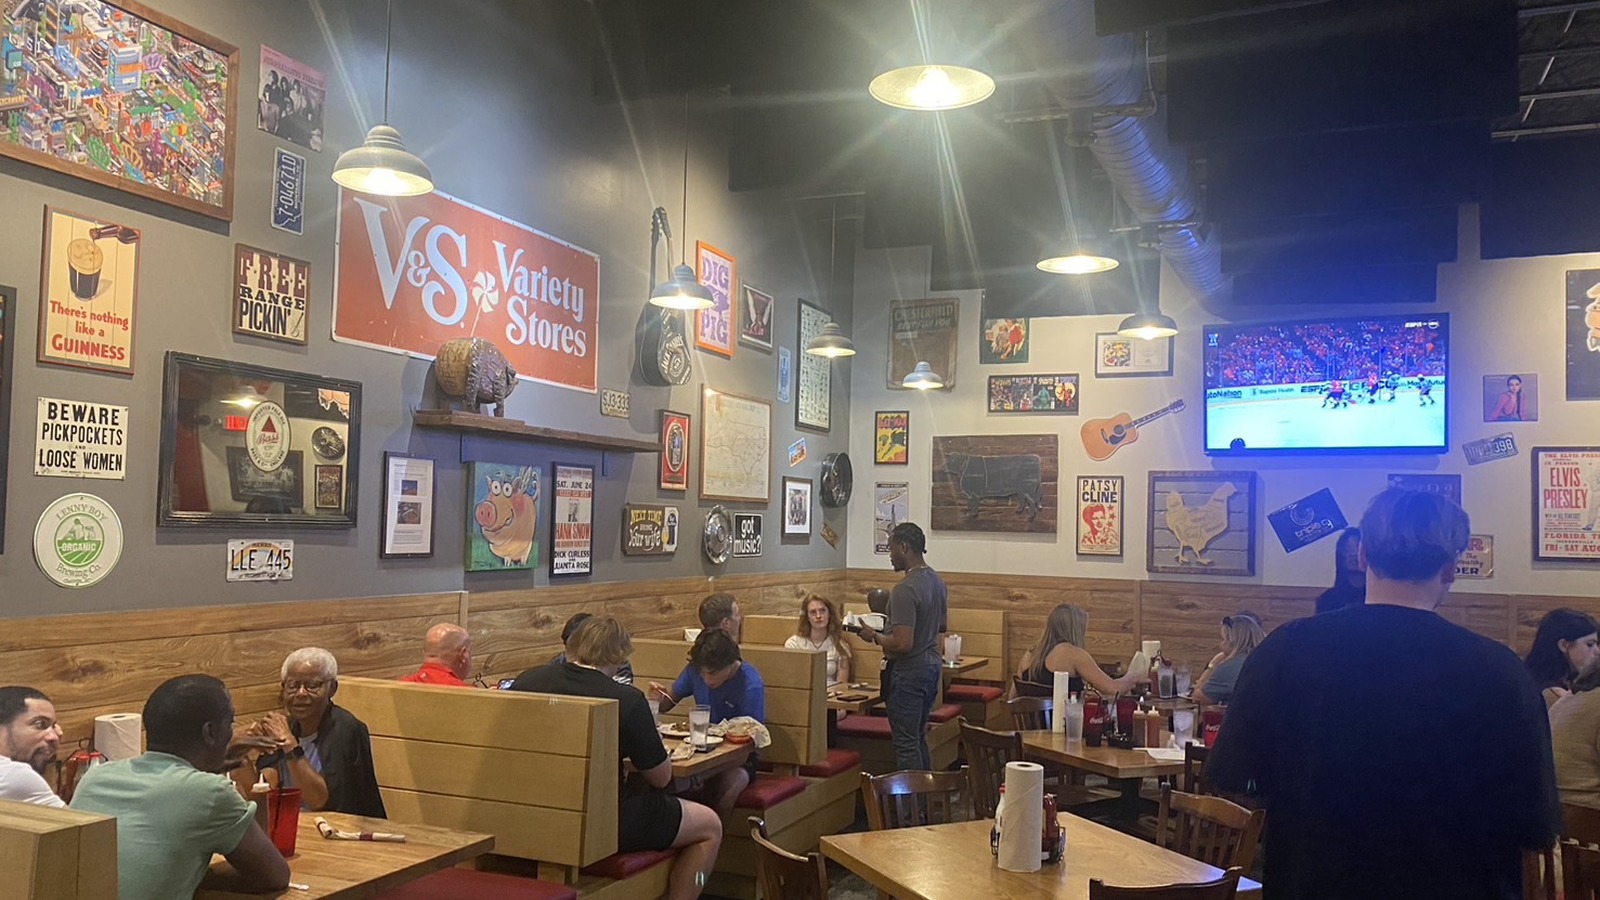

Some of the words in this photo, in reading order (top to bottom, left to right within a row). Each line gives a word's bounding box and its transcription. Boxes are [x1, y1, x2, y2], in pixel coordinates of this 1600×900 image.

[492, 239, 585, 323] Variety
[702, 255, 729, 291] DIG
[239, 285, 305, 311] RANGE
[50, 300, 87, 319] There's
[90, 311, 129, 331] nothing
[239, 298, 292, 336] PICKIN'
[75, 320, 95, 336] like
[98, 328, 105, 337] a
[505, 295, 587, 358] Stores
[701, 309, 728, 345] PIG
[51, 333, 125, 361] GUINNESS
[1207, 390, 1242, 399] utoNation
[47, 402, 120, 426] BEWARE
[42, 422, 123, 446] PICKPOCKETS
[39, 448, 77, 469] LOOSE
[83, 452, 122, 471] WOMEN
[571, 481, 583, 489] JUNE
[1082, 479, 1118, 492] PATSY
[1550, 467, 1581, 487] ELVIS
[1082, 491, 1118, 503] CLINE
[1543, 488, 1588, 509] PRESLEY
[56, 503, 88, 520] LENNY
[88, 505, 107, 522] BOY
[630, 509, 647, 525] NEXT
[647, 509, 662, 526] TIME
[741, 516, 755, 539] got
[1544, 532, 1586, 540] FLORIDA
[61, 542, 97, 552] ORGANIC
[733, 534, 762, 554] music?
[1545, 544, 1558, 552] FRI
[1564, 544, 1579, 552] SAT
[231, 549, 257, 571] LLE
[266, 549, 291, 571] 445
[554, 550, 566, 559] DICK
[567, 550, 590, 558] CURLESS
[1460, 560, 1484, 569] ealthy
[56, 563, 89, 579] Brewing
[576, 561, 590, 569] ROSE
